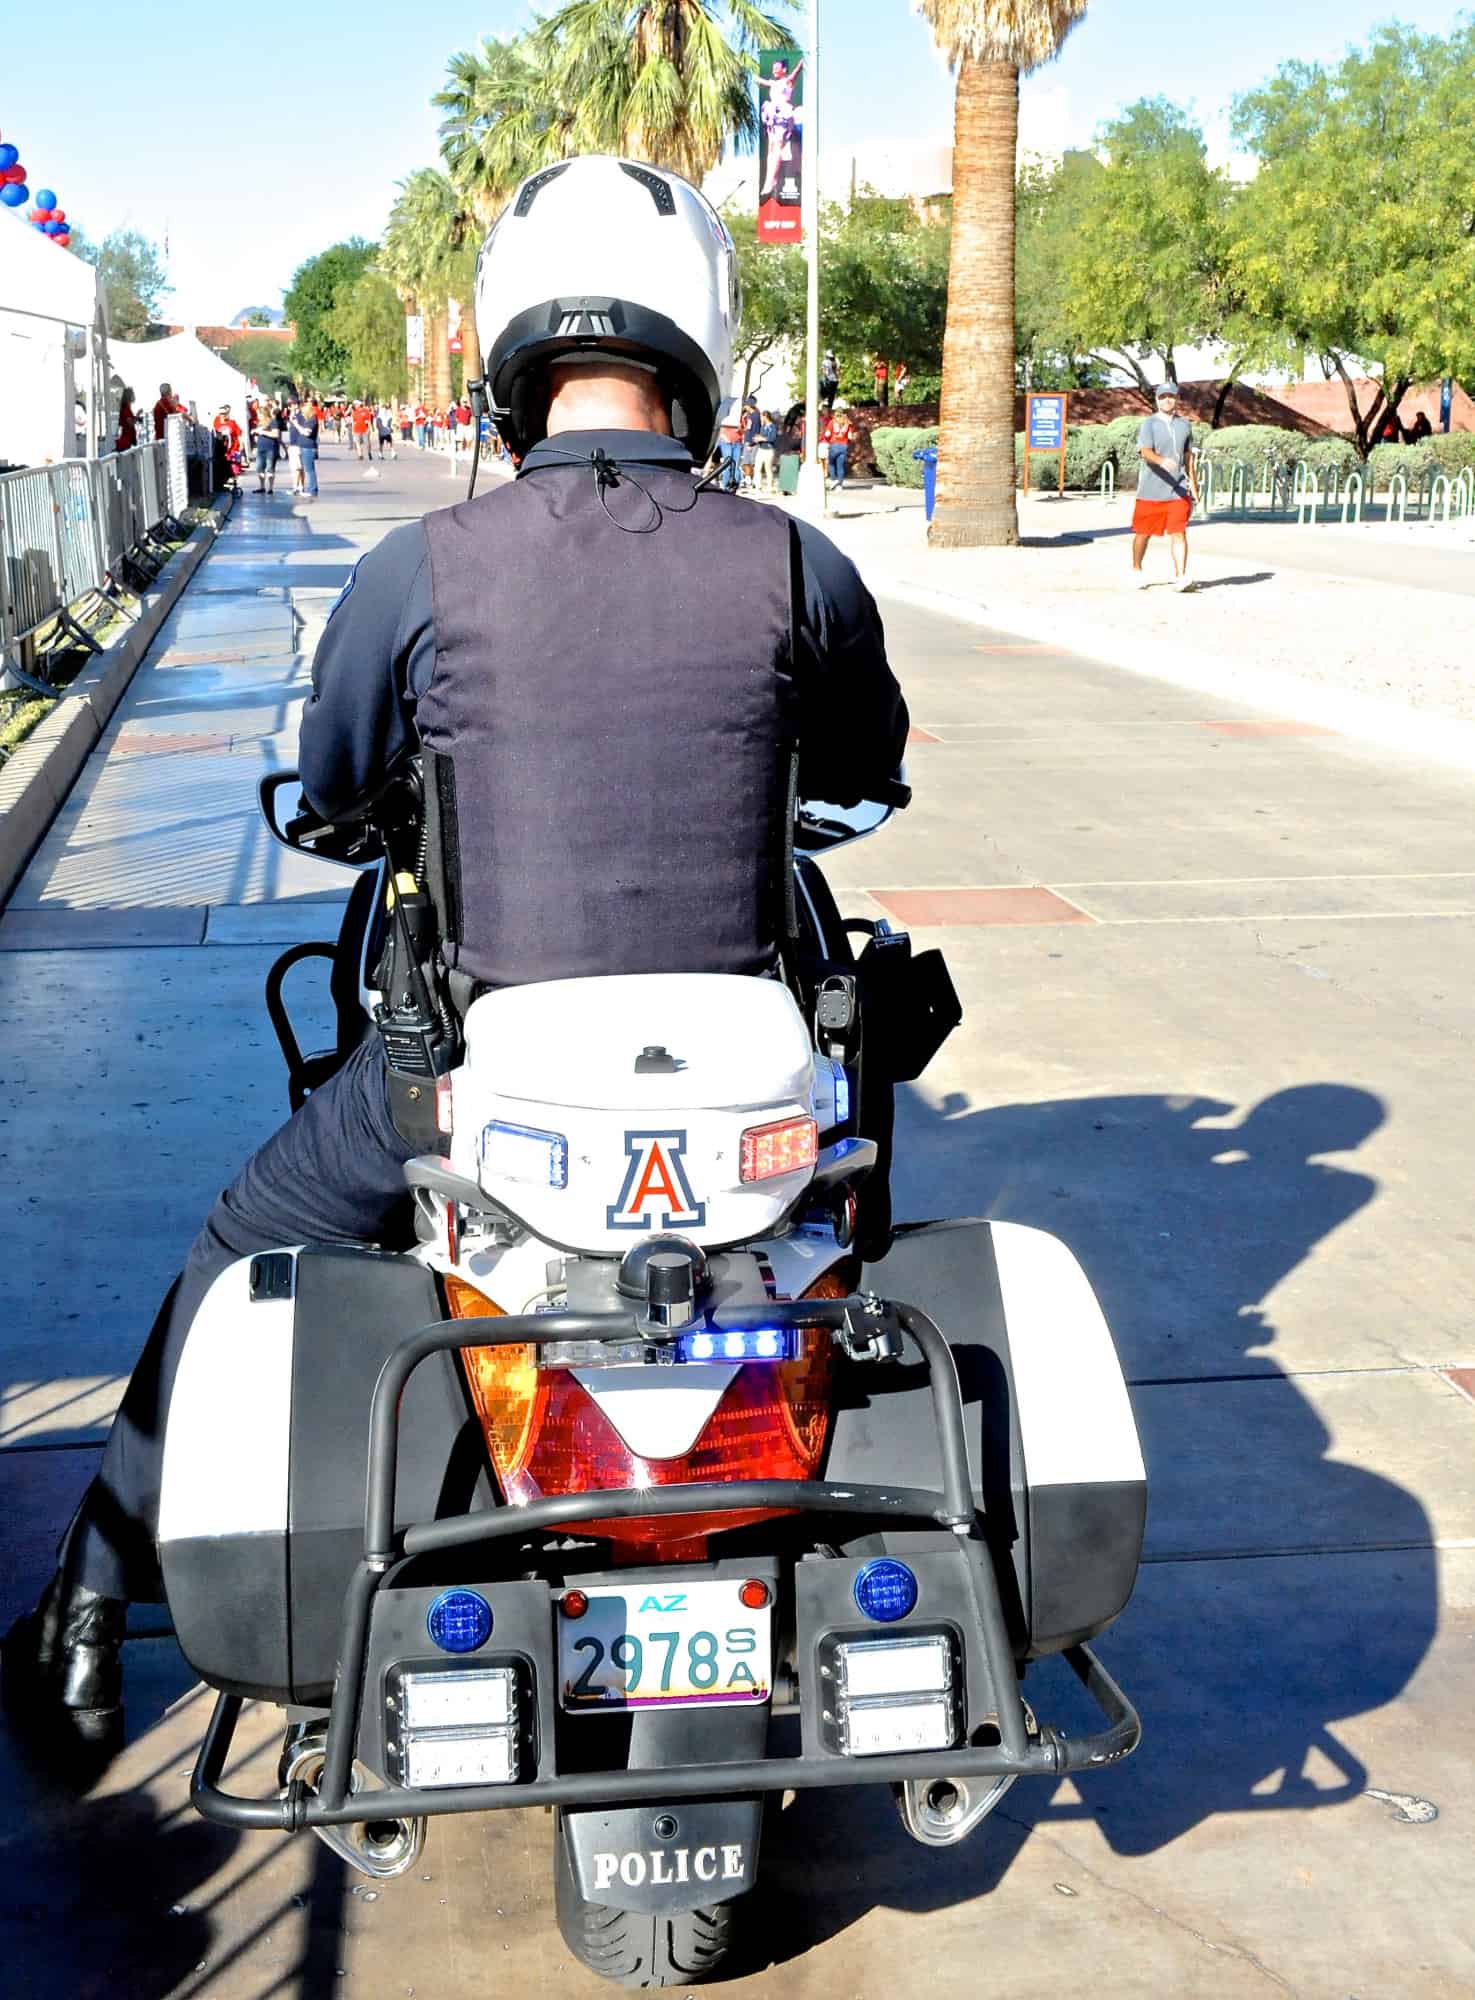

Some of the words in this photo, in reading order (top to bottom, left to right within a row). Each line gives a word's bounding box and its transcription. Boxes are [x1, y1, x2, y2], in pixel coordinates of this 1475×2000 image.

[606, 1129, 706, 1231] A
[638, 1594, 688, 1612] AZ
[592, 1844, 745, 1889] POLICE
